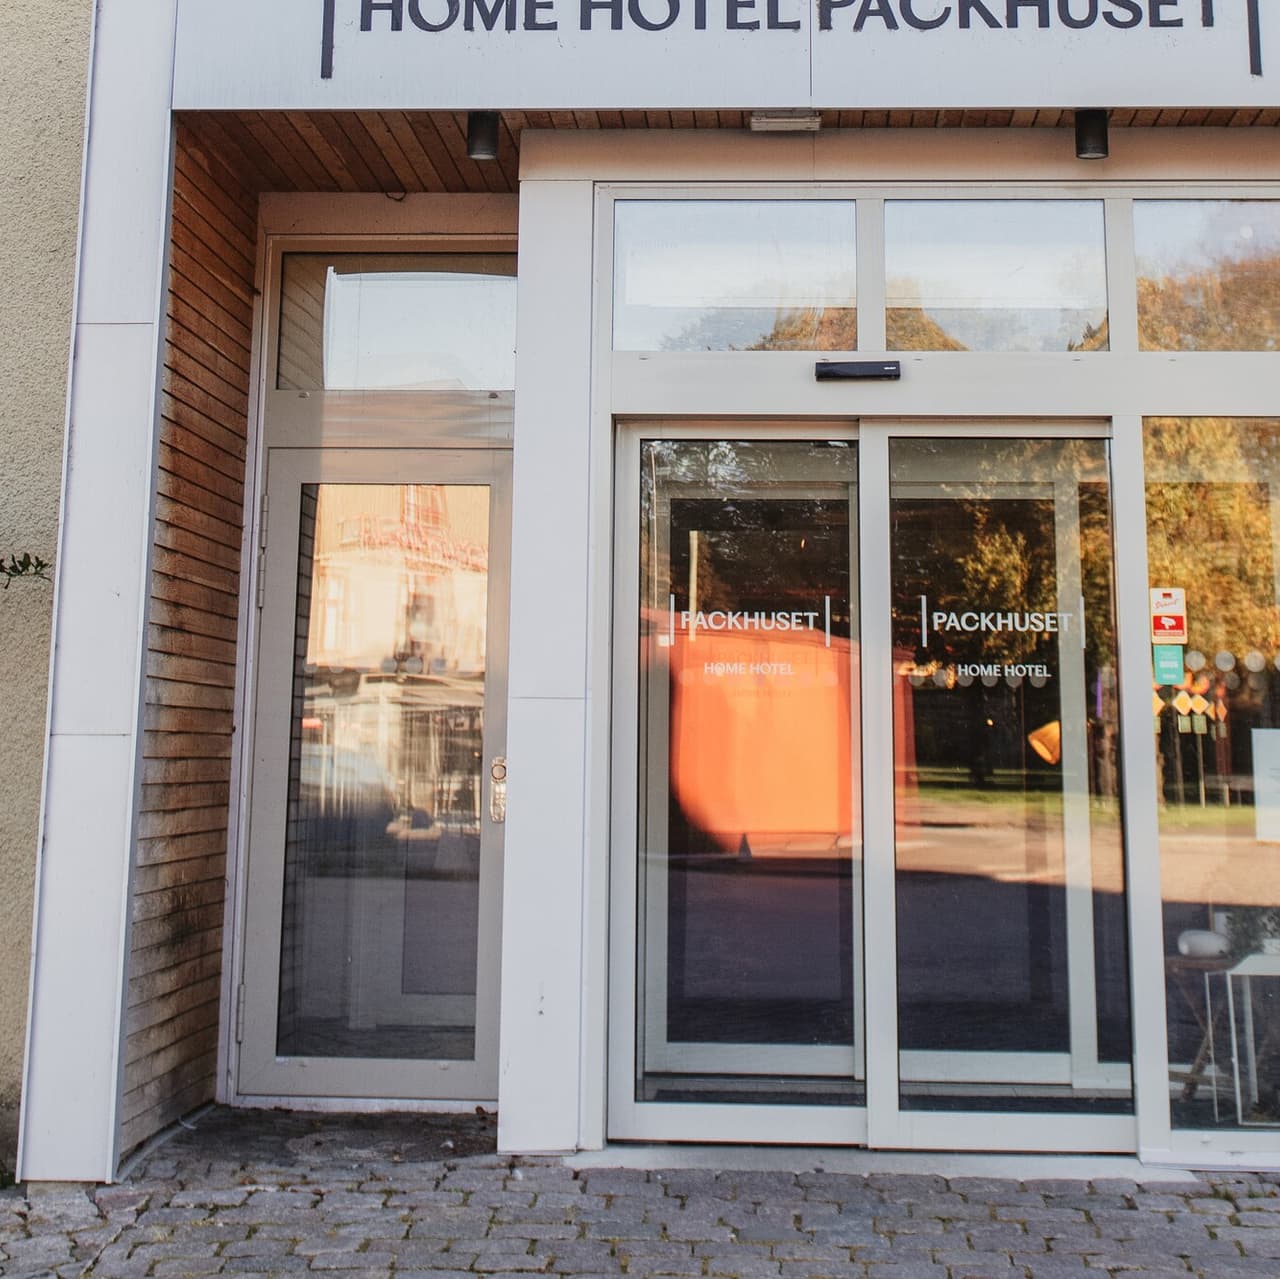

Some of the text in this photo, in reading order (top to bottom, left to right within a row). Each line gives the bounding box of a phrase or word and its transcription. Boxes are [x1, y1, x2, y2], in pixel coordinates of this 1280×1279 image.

[680, 610, 820, 631] PACKHUSET
[932, 611, 1073, 632] PACKHUSET
[703, 662, 795, 676] HOME HOTEL
[957, 663, 1052, 678] HOME HOTEL
